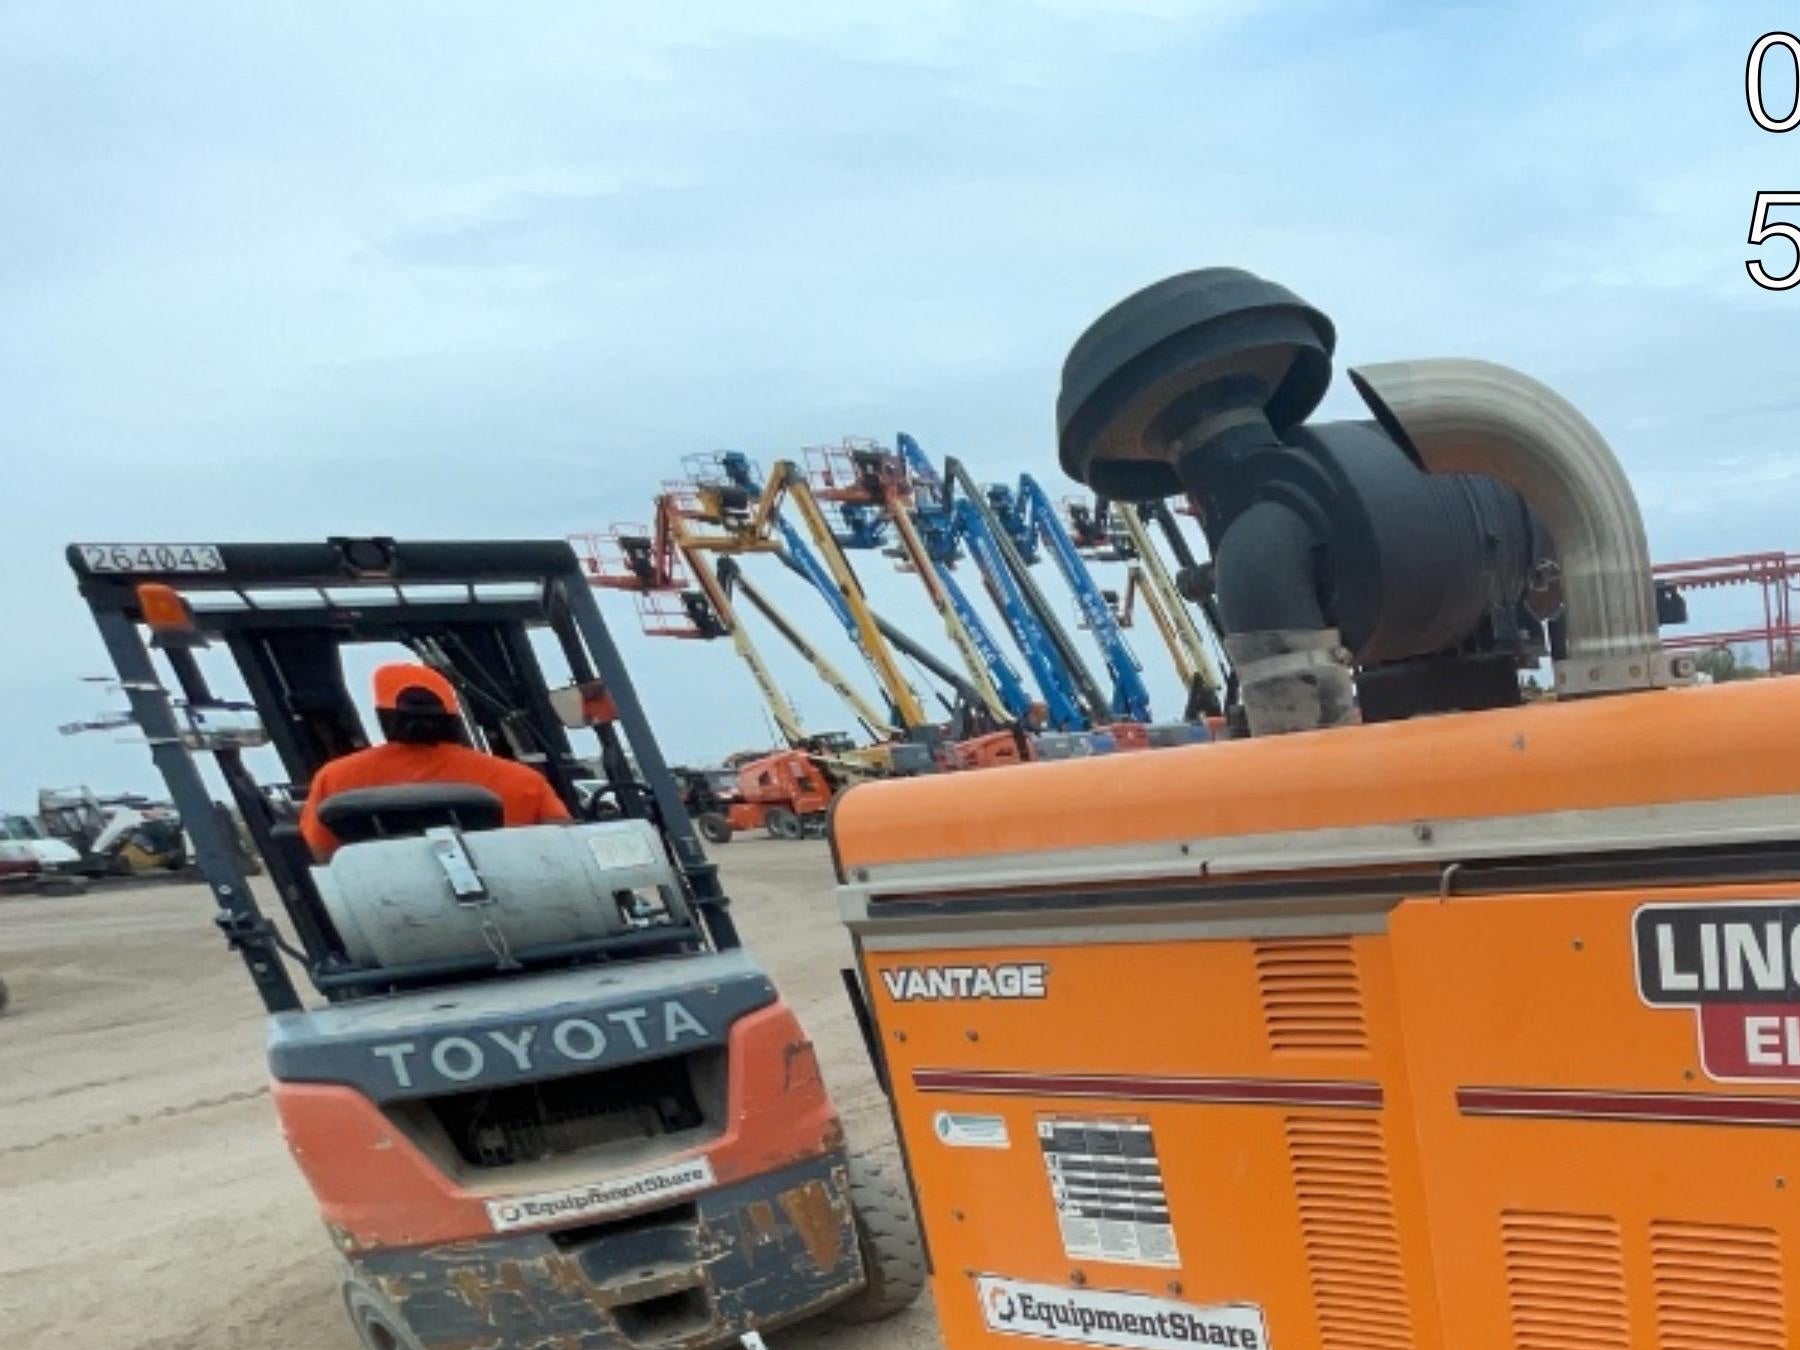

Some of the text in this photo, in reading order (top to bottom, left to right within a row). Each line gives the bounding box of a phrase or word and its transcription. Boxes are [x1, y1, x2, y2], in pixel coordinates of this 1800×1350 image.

[881, 963, 1047, 1000] VANTAGE
[374, 1001, 708, 1088] TOYOTA
[1017, 1292, 1259, 1350] EquipmentShare
